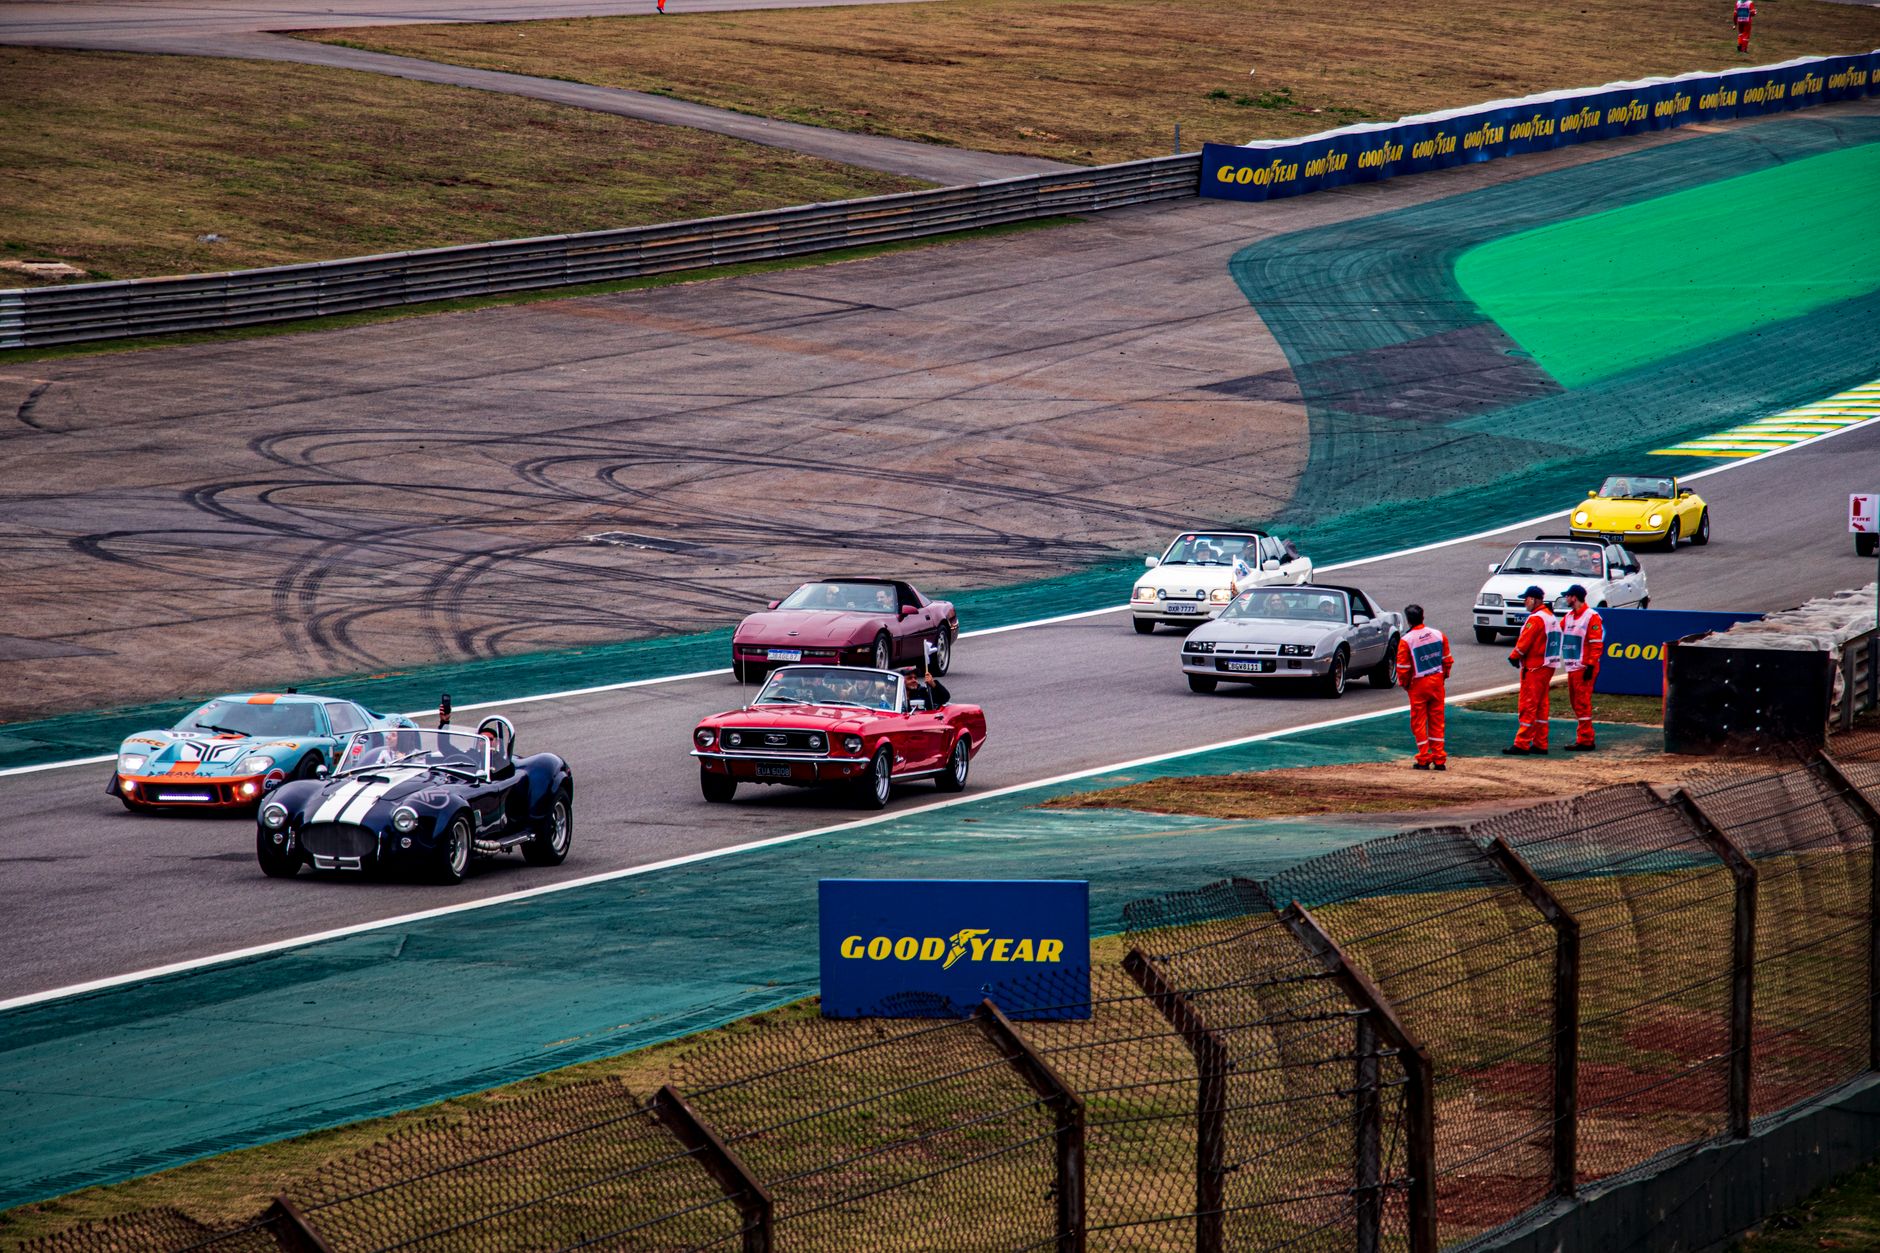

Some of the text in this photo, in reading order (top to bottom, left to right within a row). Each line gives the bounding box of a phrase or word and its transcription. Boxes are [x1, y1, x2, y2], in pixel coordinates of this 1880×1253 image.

[1217, 160, 1298, 187] GOODYEAR
[1304, 153, 1348, 178] GOODYEAR
[1358, 143, 1403, 168] GOODYEAR
[1412, 134, 1457, 158] GOODYEAR
[1463, 125, 1504, 150] GOODYEAR
[1510, 117, 1555, 140] GOODYEAR
[840, 931, 1064, 966] GOODYEAR
